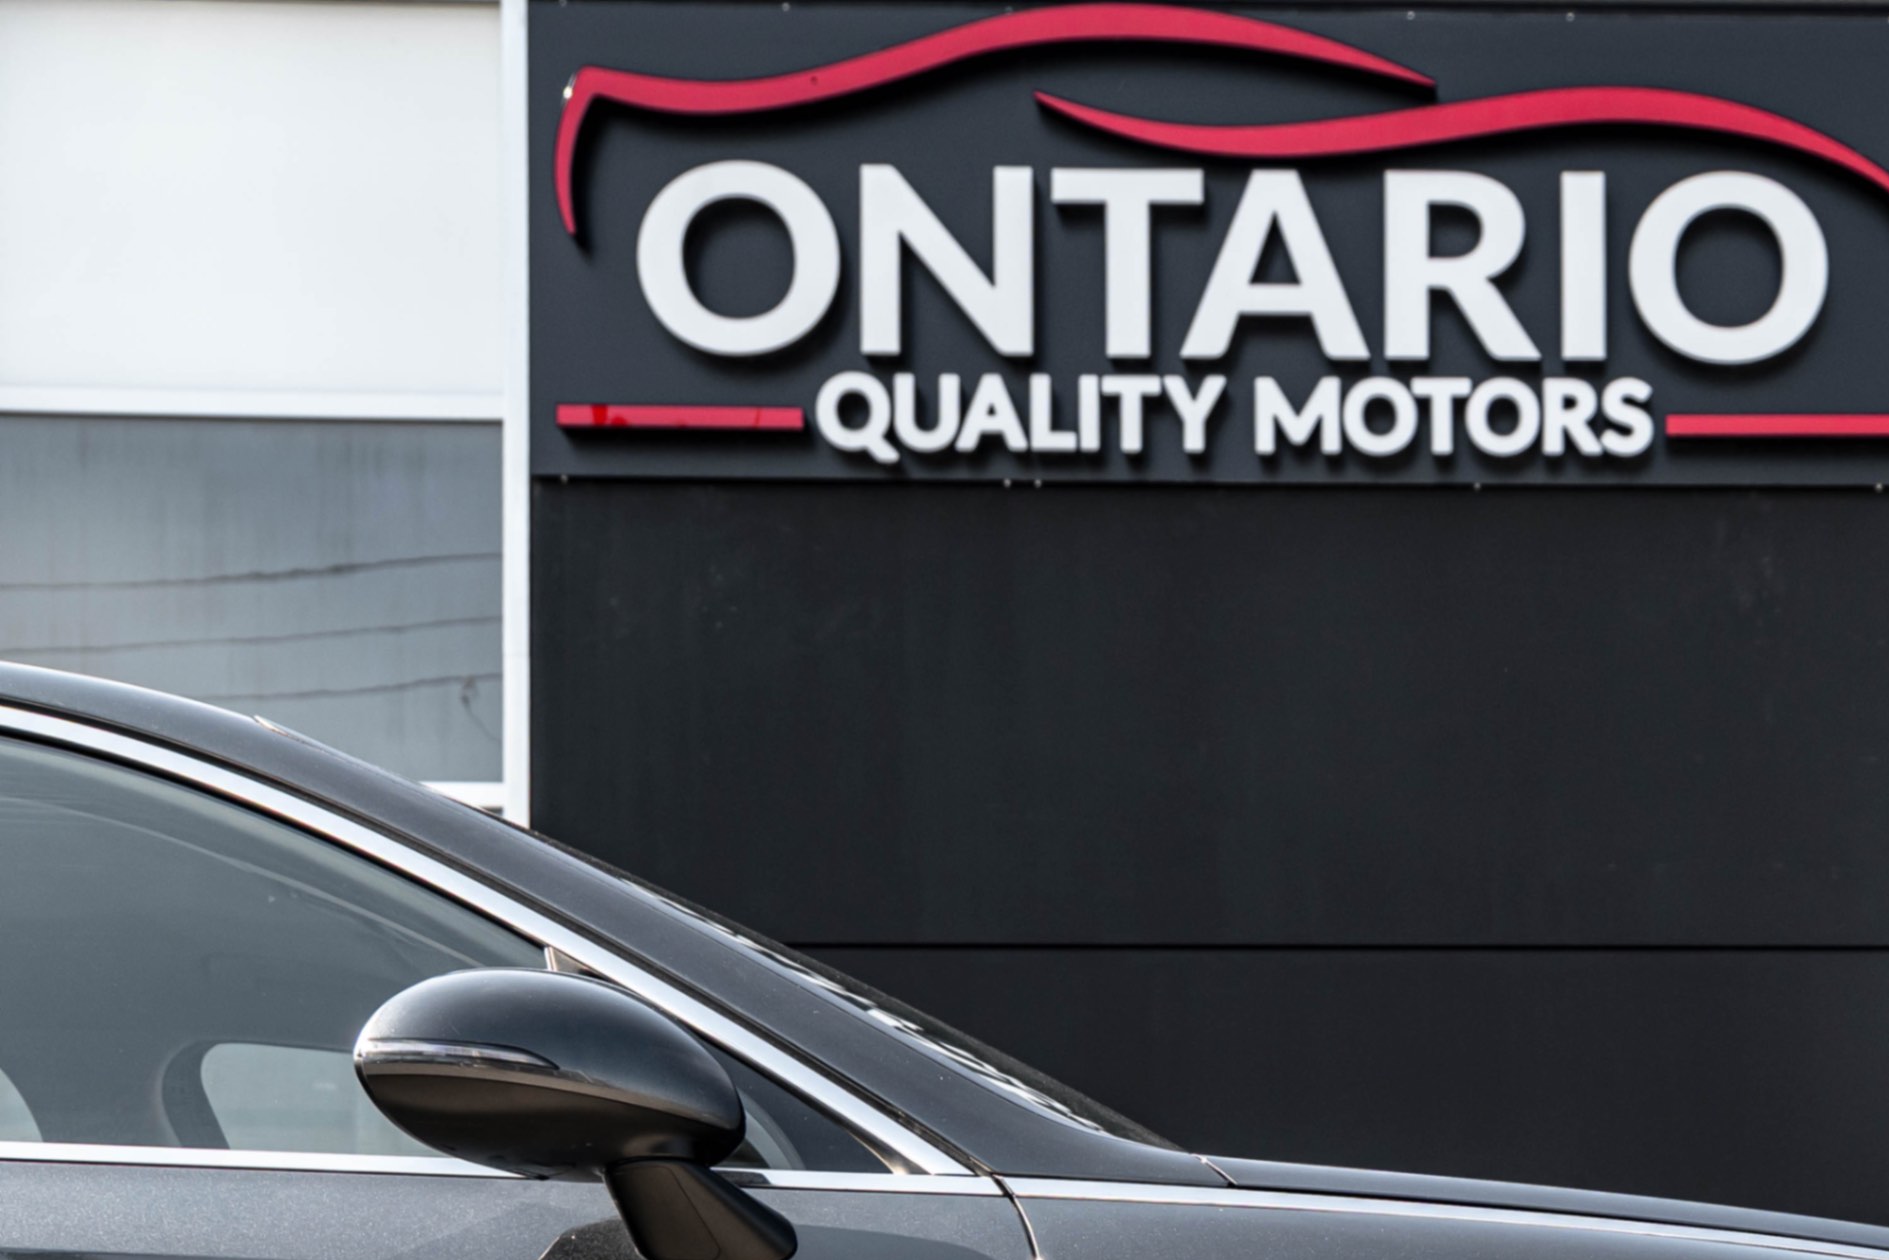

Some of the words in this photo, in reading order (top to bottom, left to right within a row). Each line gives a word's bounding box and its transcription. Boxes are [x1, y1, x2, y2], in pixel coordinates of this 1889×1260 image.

[636, 160, 1829, 364] ONTARIO
[815, 371, 1227, 463] QUALITY
[1253, 376, 1654, 456] MOTORS
